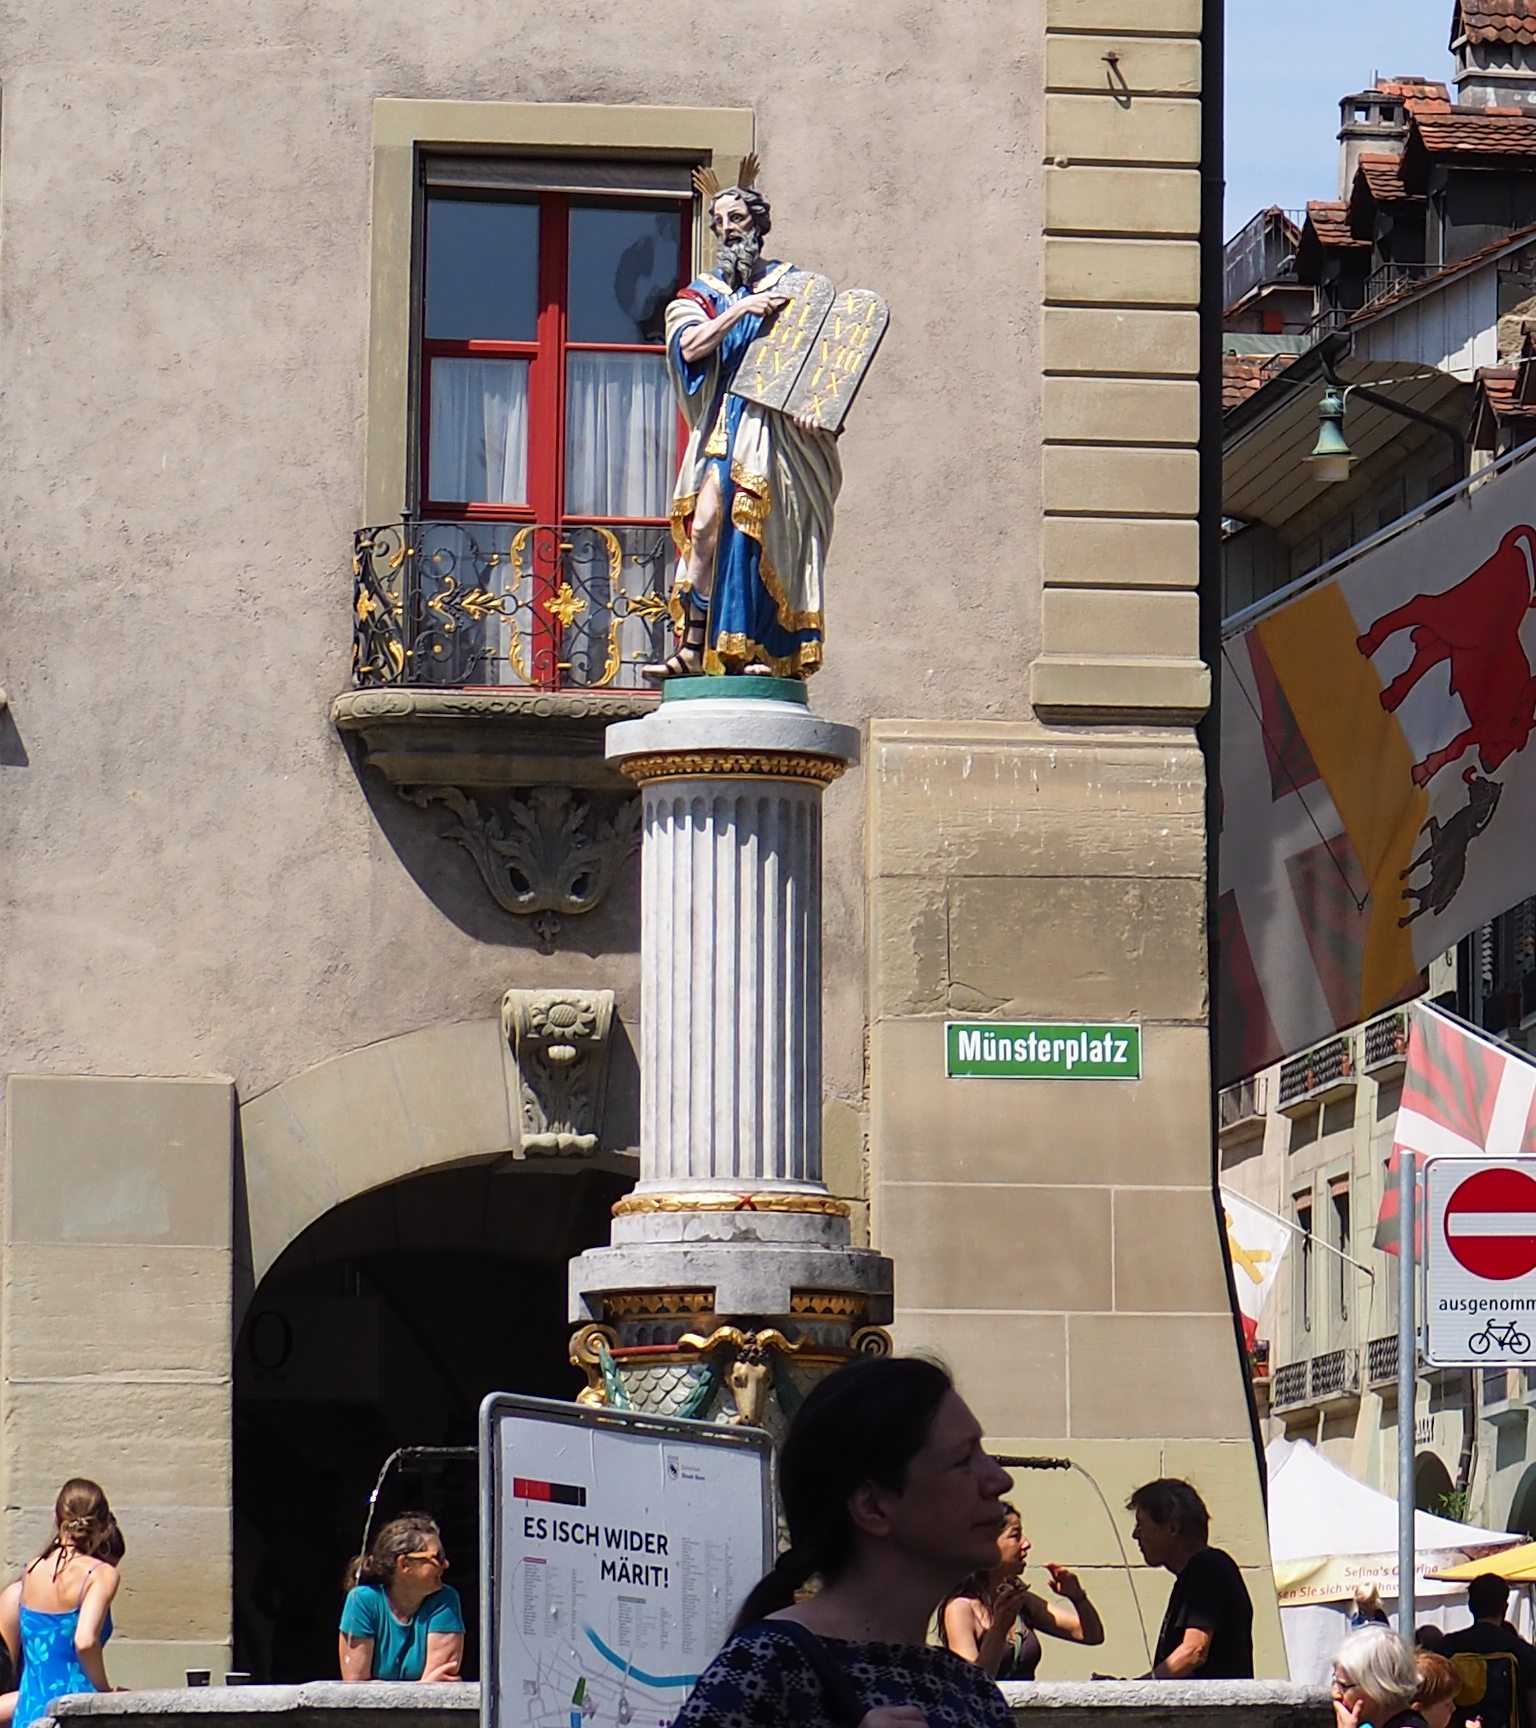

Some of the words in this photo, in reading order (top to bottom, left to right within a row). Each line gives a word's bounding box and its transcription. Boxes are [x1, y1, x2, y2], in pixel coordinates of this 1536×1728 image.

[958, 1029, 1129, 1070] Münsterplatz
[524, 1517, 548, 1540] ES
[553, 1521, 599, 1547] ISCH
[604, 1527, 669, 1556] WIDER
[601, 1556, 670, 1588] MÄRIT!
